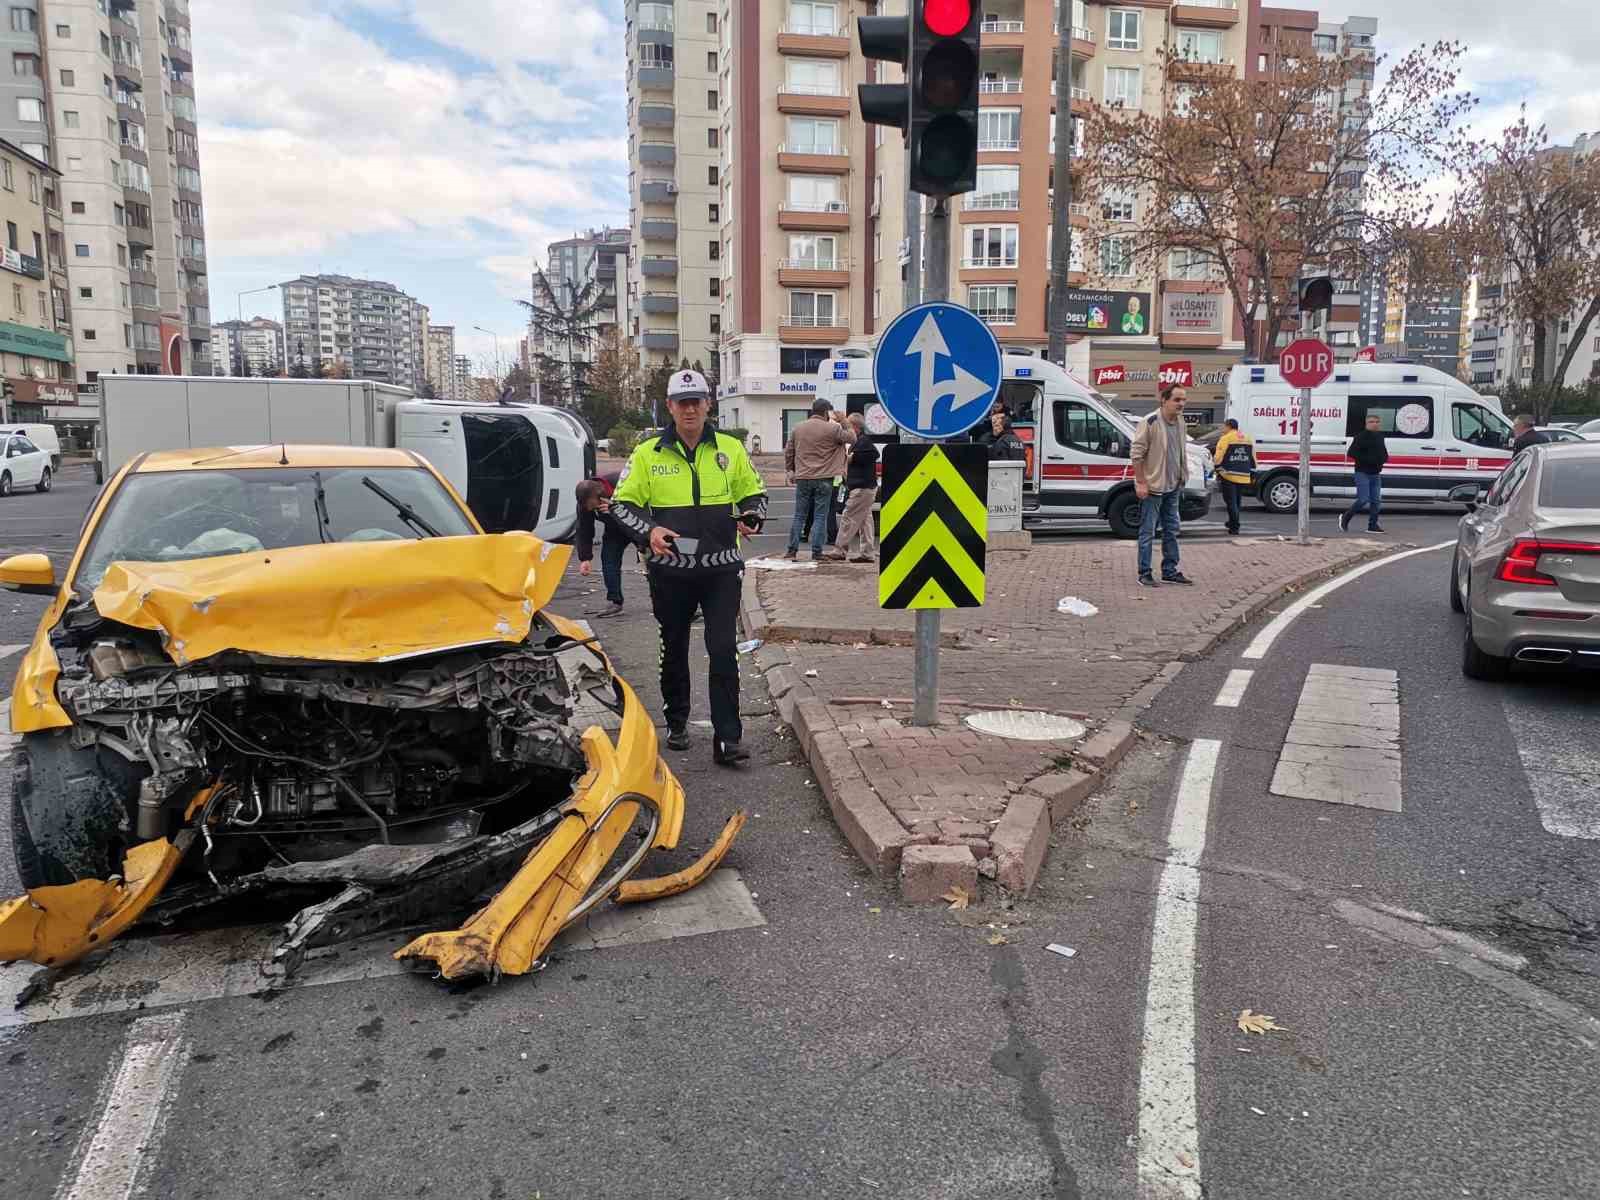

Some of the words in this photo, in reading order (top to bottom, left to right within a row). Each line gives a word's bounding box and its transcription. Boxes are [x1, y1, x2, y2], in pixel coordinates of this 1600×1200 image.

[1066, 312, 1087, 322] ÖSEV
[1284, 353, 1328, 374] DUR
[1253, 405, 1286, 417] SAĞLIK
[1291, 407, 1342, 418] BAANLIĞI
[651, 464, 680, 475] POLİS
